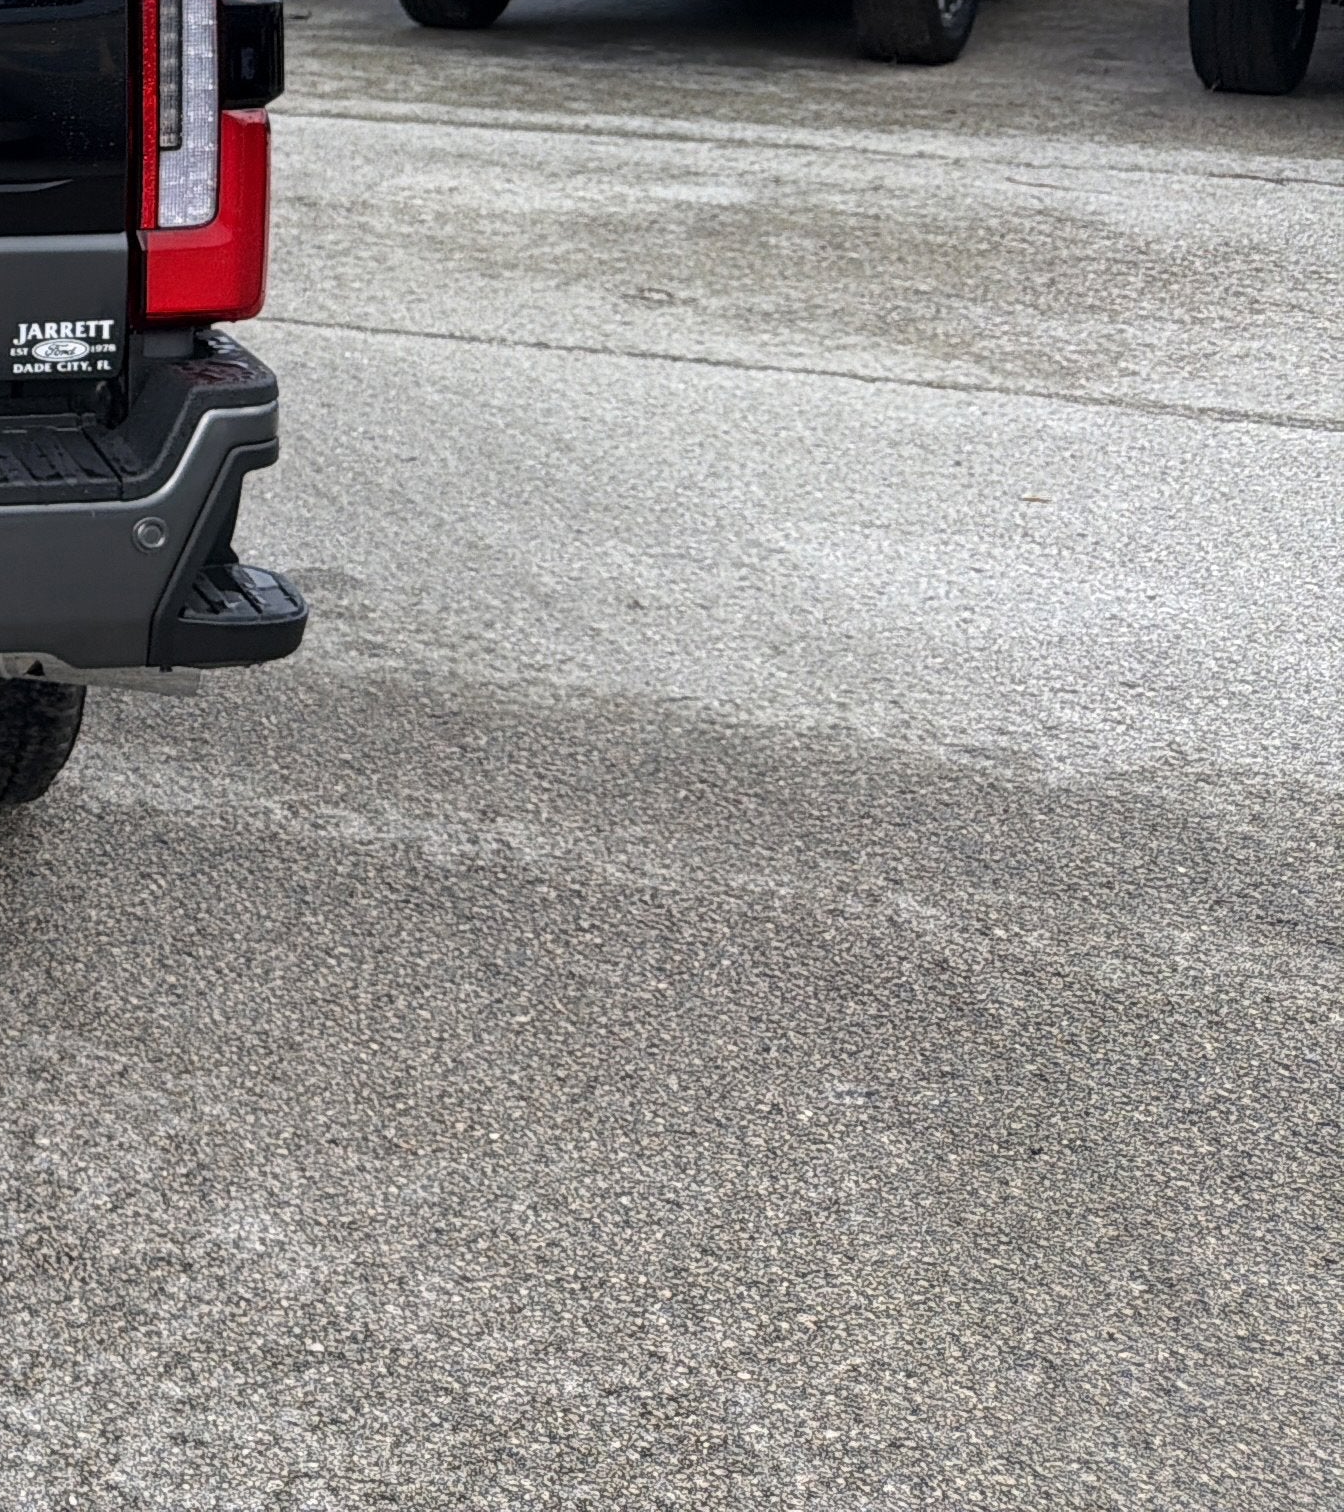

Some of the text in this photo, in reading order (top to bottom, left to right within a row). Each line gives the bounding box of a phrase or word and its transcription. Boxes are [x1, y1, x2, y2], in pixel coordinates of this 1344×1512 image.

[12, 319, 115, 346] JARRETT
[10, 347, 29, 357] EST
[44, 343, 78, 358] Ford
[12, 363, 52, 374] DADE
[96, 360, 112, 371] FL
